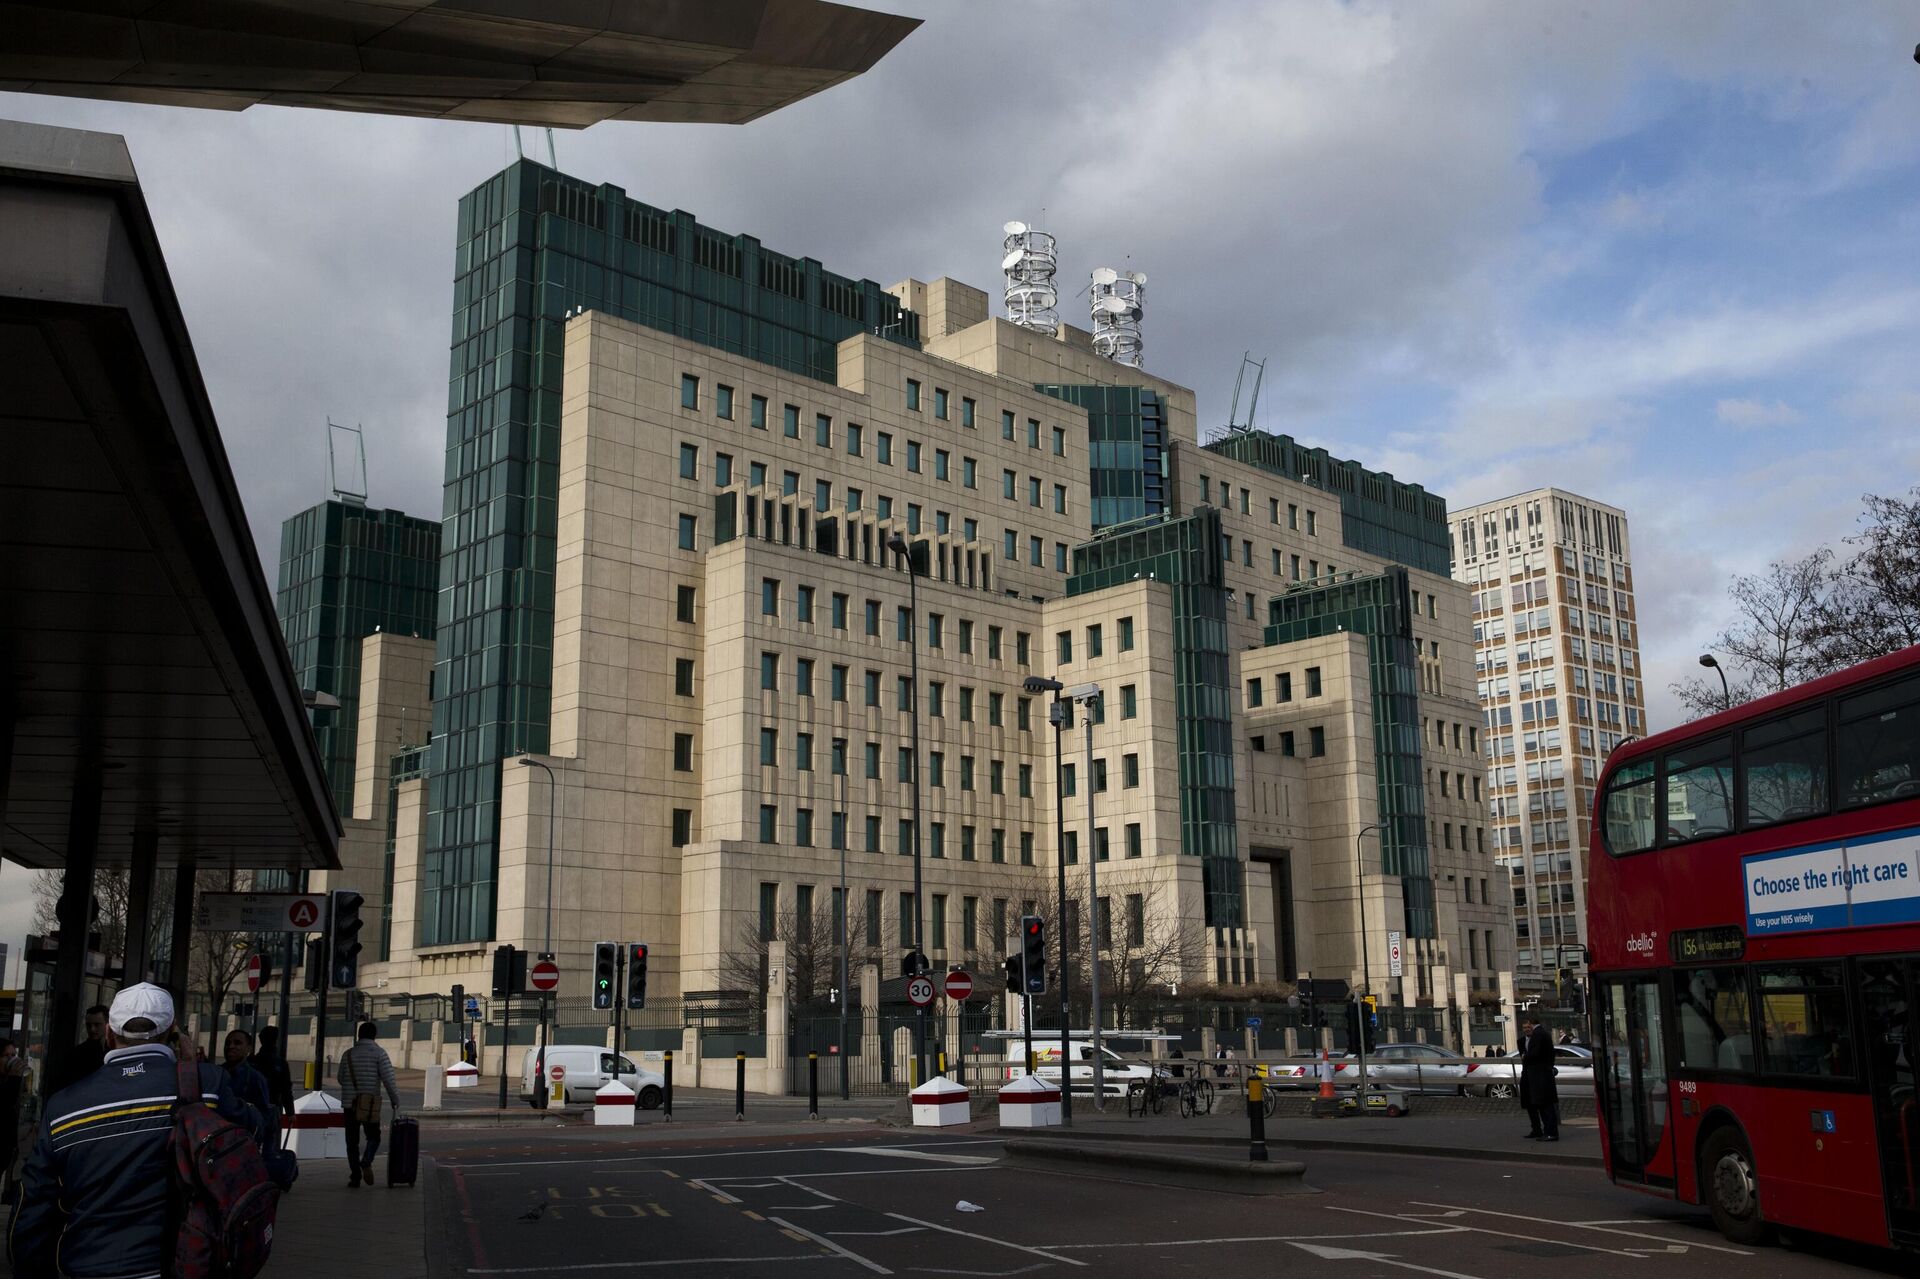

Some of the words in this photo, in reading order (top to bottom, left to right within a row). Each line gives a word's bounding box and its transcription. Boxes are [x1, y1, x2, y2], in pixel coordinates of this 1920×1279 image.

[1753, 876, 1800, 896] Choose
[1803, 869, 1828, 890] the
[1831, 863, 1869, 891] right
[1873, 862, 1908, 882] care
[295, 905, 312, 922] A
[1755, 916, 1766, 927] Use
[1766, 915, 1781, 928] your
[1781, 914, 1793, 925] NHS
[1793, 912, 1814, 925] wisely
[1626, 931, 1654, 952] abellio
[1683, 937, 1697, 955] 156
[911, 984, 931, 998] 30
[122, 1063, 146, 1077] EVERLAST
[1679, 1080, 1697, 1094] 9489
